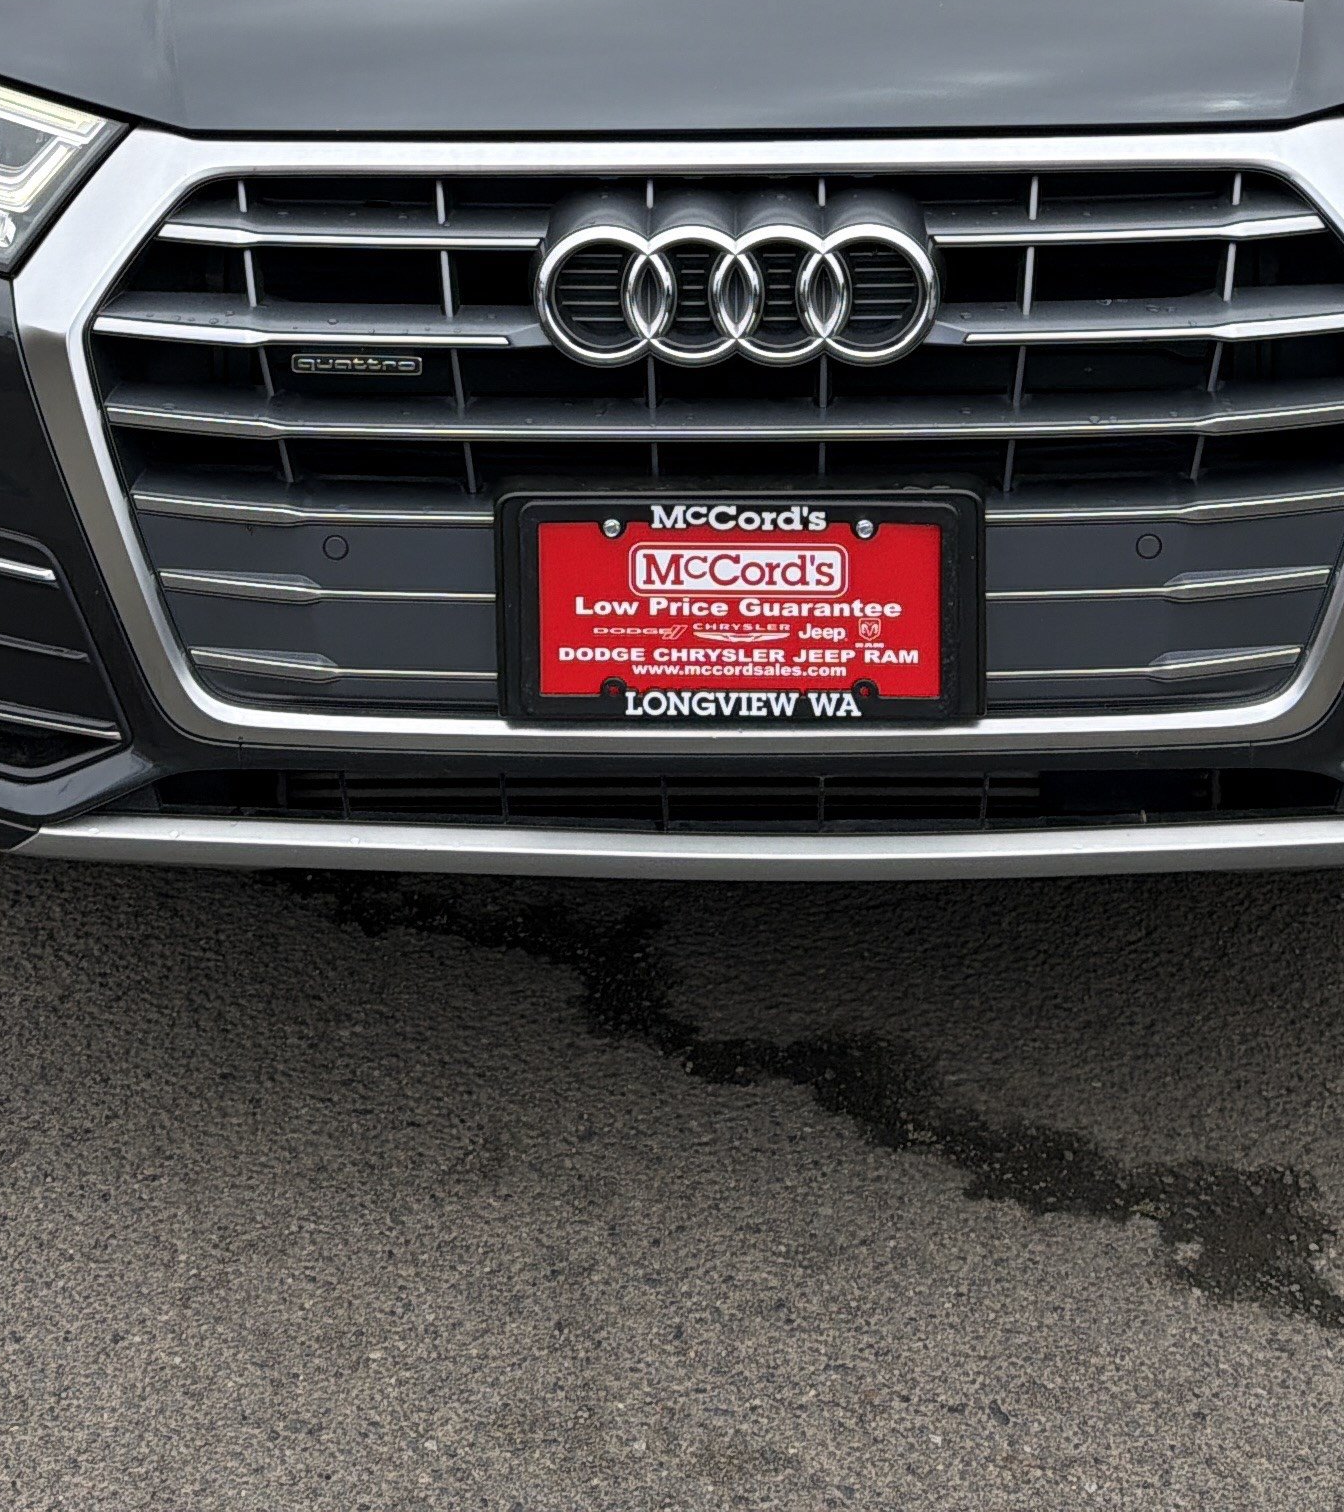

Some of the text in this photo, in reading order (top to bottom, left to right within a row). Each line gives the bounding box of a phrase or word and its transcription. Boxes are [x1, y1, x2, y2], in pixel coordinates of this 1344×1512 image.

[296, 358, 416, 372] quattro
[651, 505, 827, 531] McCord's
[642, 553, 835, 587] McCord's
[575, 596, 903, 618] Low Price Guarantee
[692, 622, 791, 631] CHRYSLER
[798, 623, 846, 642] Jeep
[558, 647, 919, 664] DODGE CHRYSLER JEEP RAM
[632, 662, 847, 677] www.mccordsales.com
[625, 691, 862, 717] LONGVIEW WA
